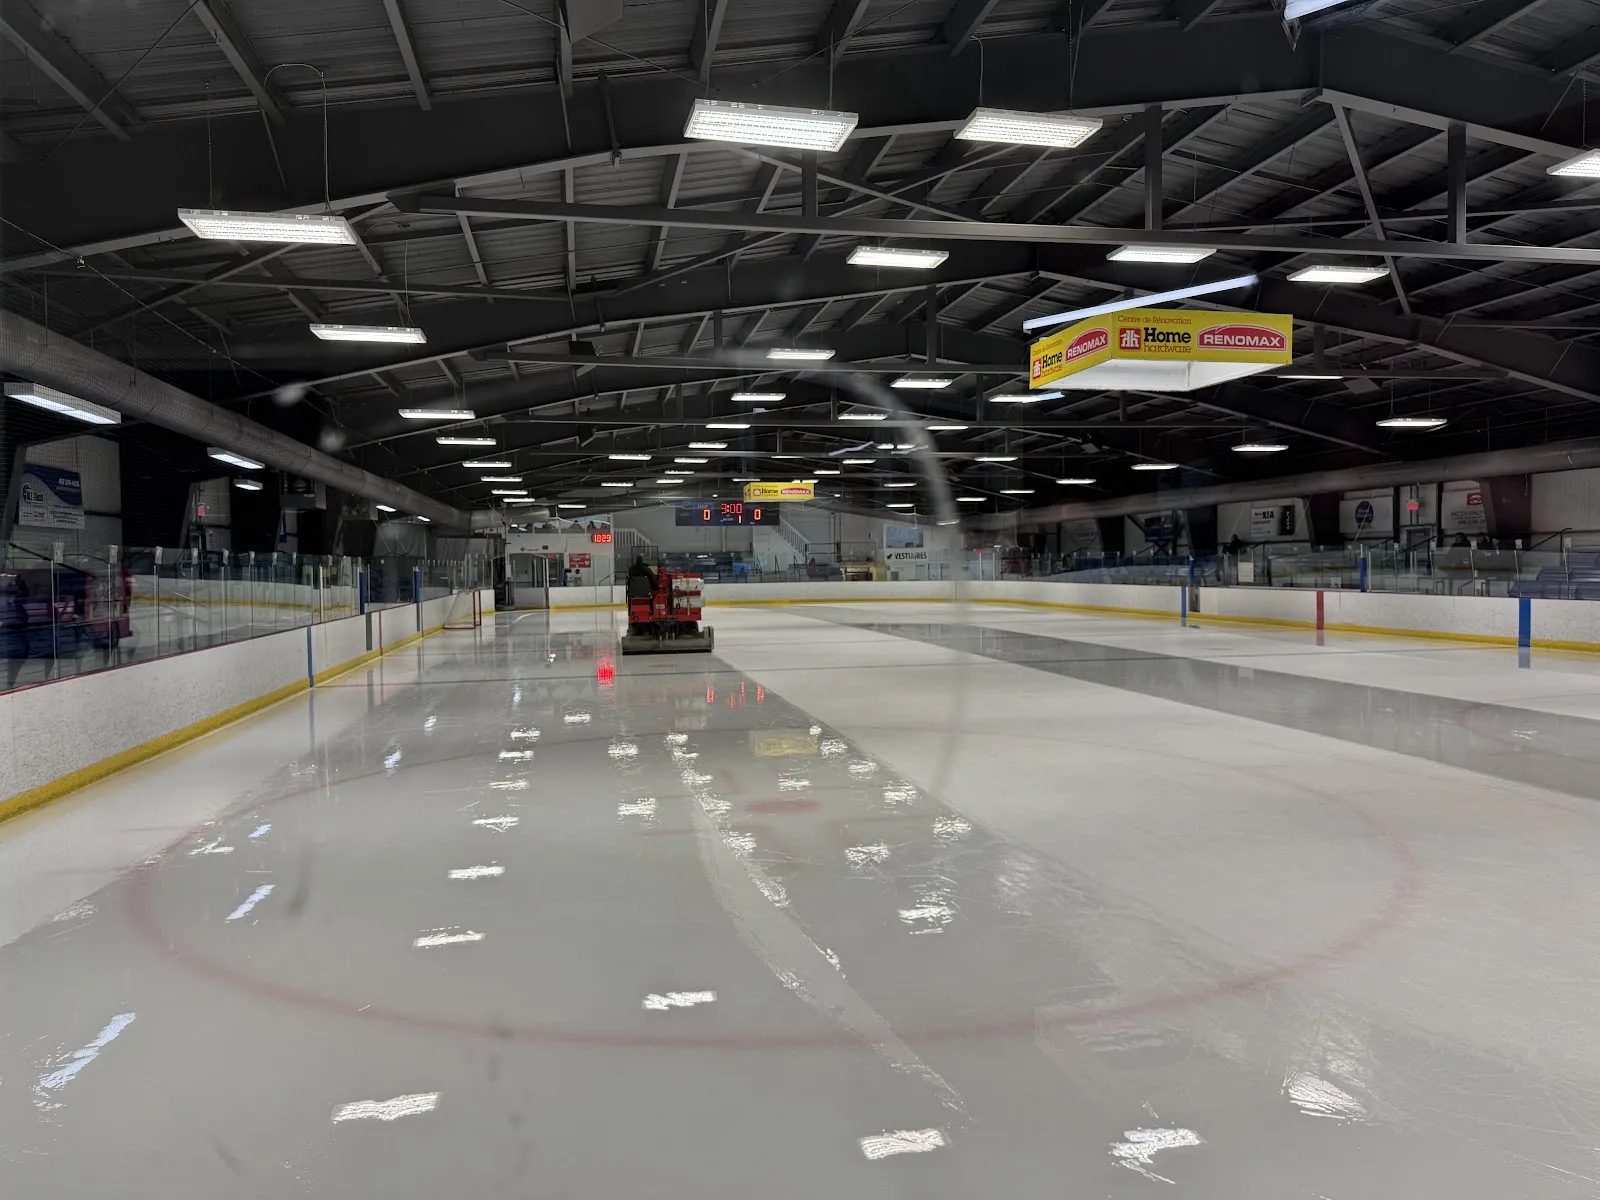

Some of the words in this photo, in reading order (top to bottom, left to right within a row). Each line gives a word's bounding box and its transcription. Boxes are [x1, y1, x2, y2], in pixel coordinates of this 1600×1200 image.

[1117, 315, 1141, 324] Centre
[1141, 316, 1152, 324] de
[1153, 316, 1192, 325] Rénovation
[1143, 327, 1192, 344] Home
[1203, 334, 1281, 347] RENOMAX
[1067, 334, 1106, 359] RENOMAX
[1143, 343, 1192, 353] hardware
[1042, 351, 1063, 368] Home
[703, 509, 711, 520] 0
[721, 504, 742, 514] 3:00
[754, 509, 761, 520] 0
[1262, 511, 1274, 519] KIA
